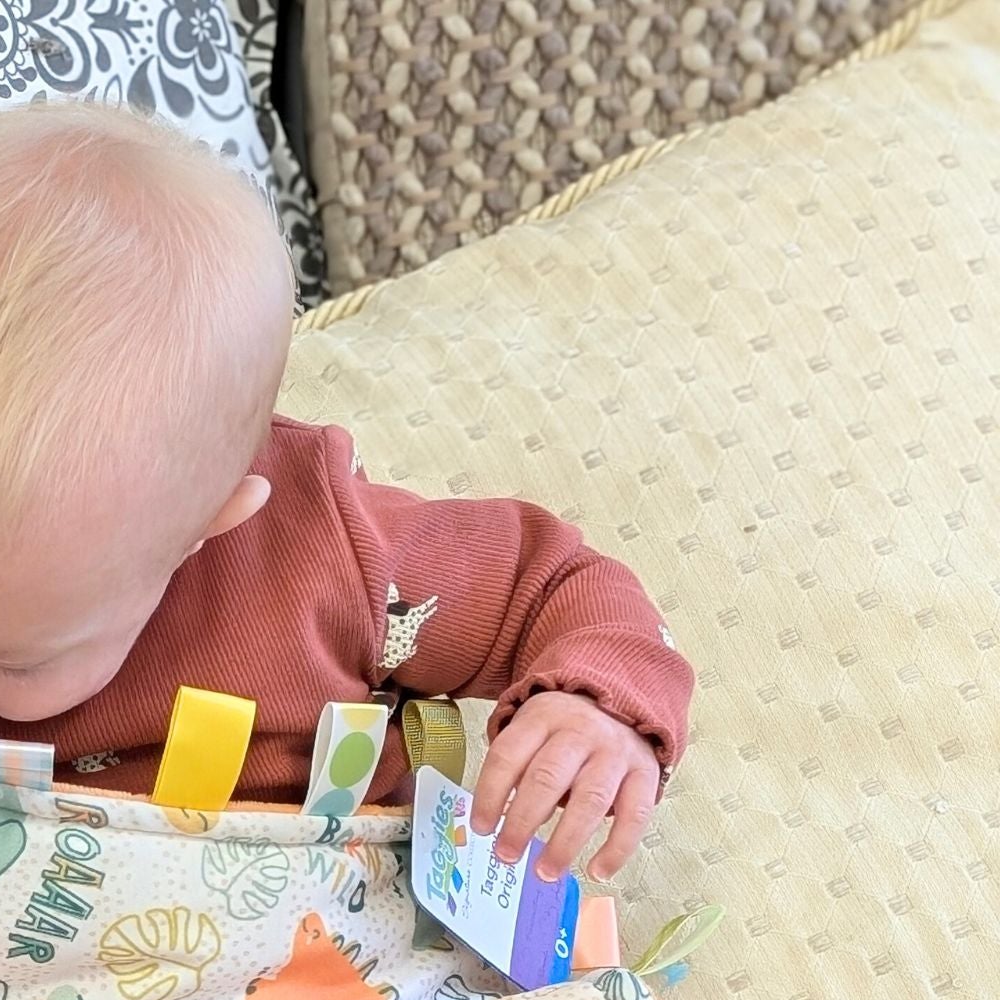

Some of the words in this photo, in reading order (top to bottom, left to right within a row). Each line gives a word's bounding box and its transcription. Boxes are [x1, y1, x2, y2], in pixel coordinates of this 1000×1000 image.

[5, 797, 110, 964] ROAAAR
[306, 846, 367, 914] WILD
[497, 862, 517, 910] Origi
